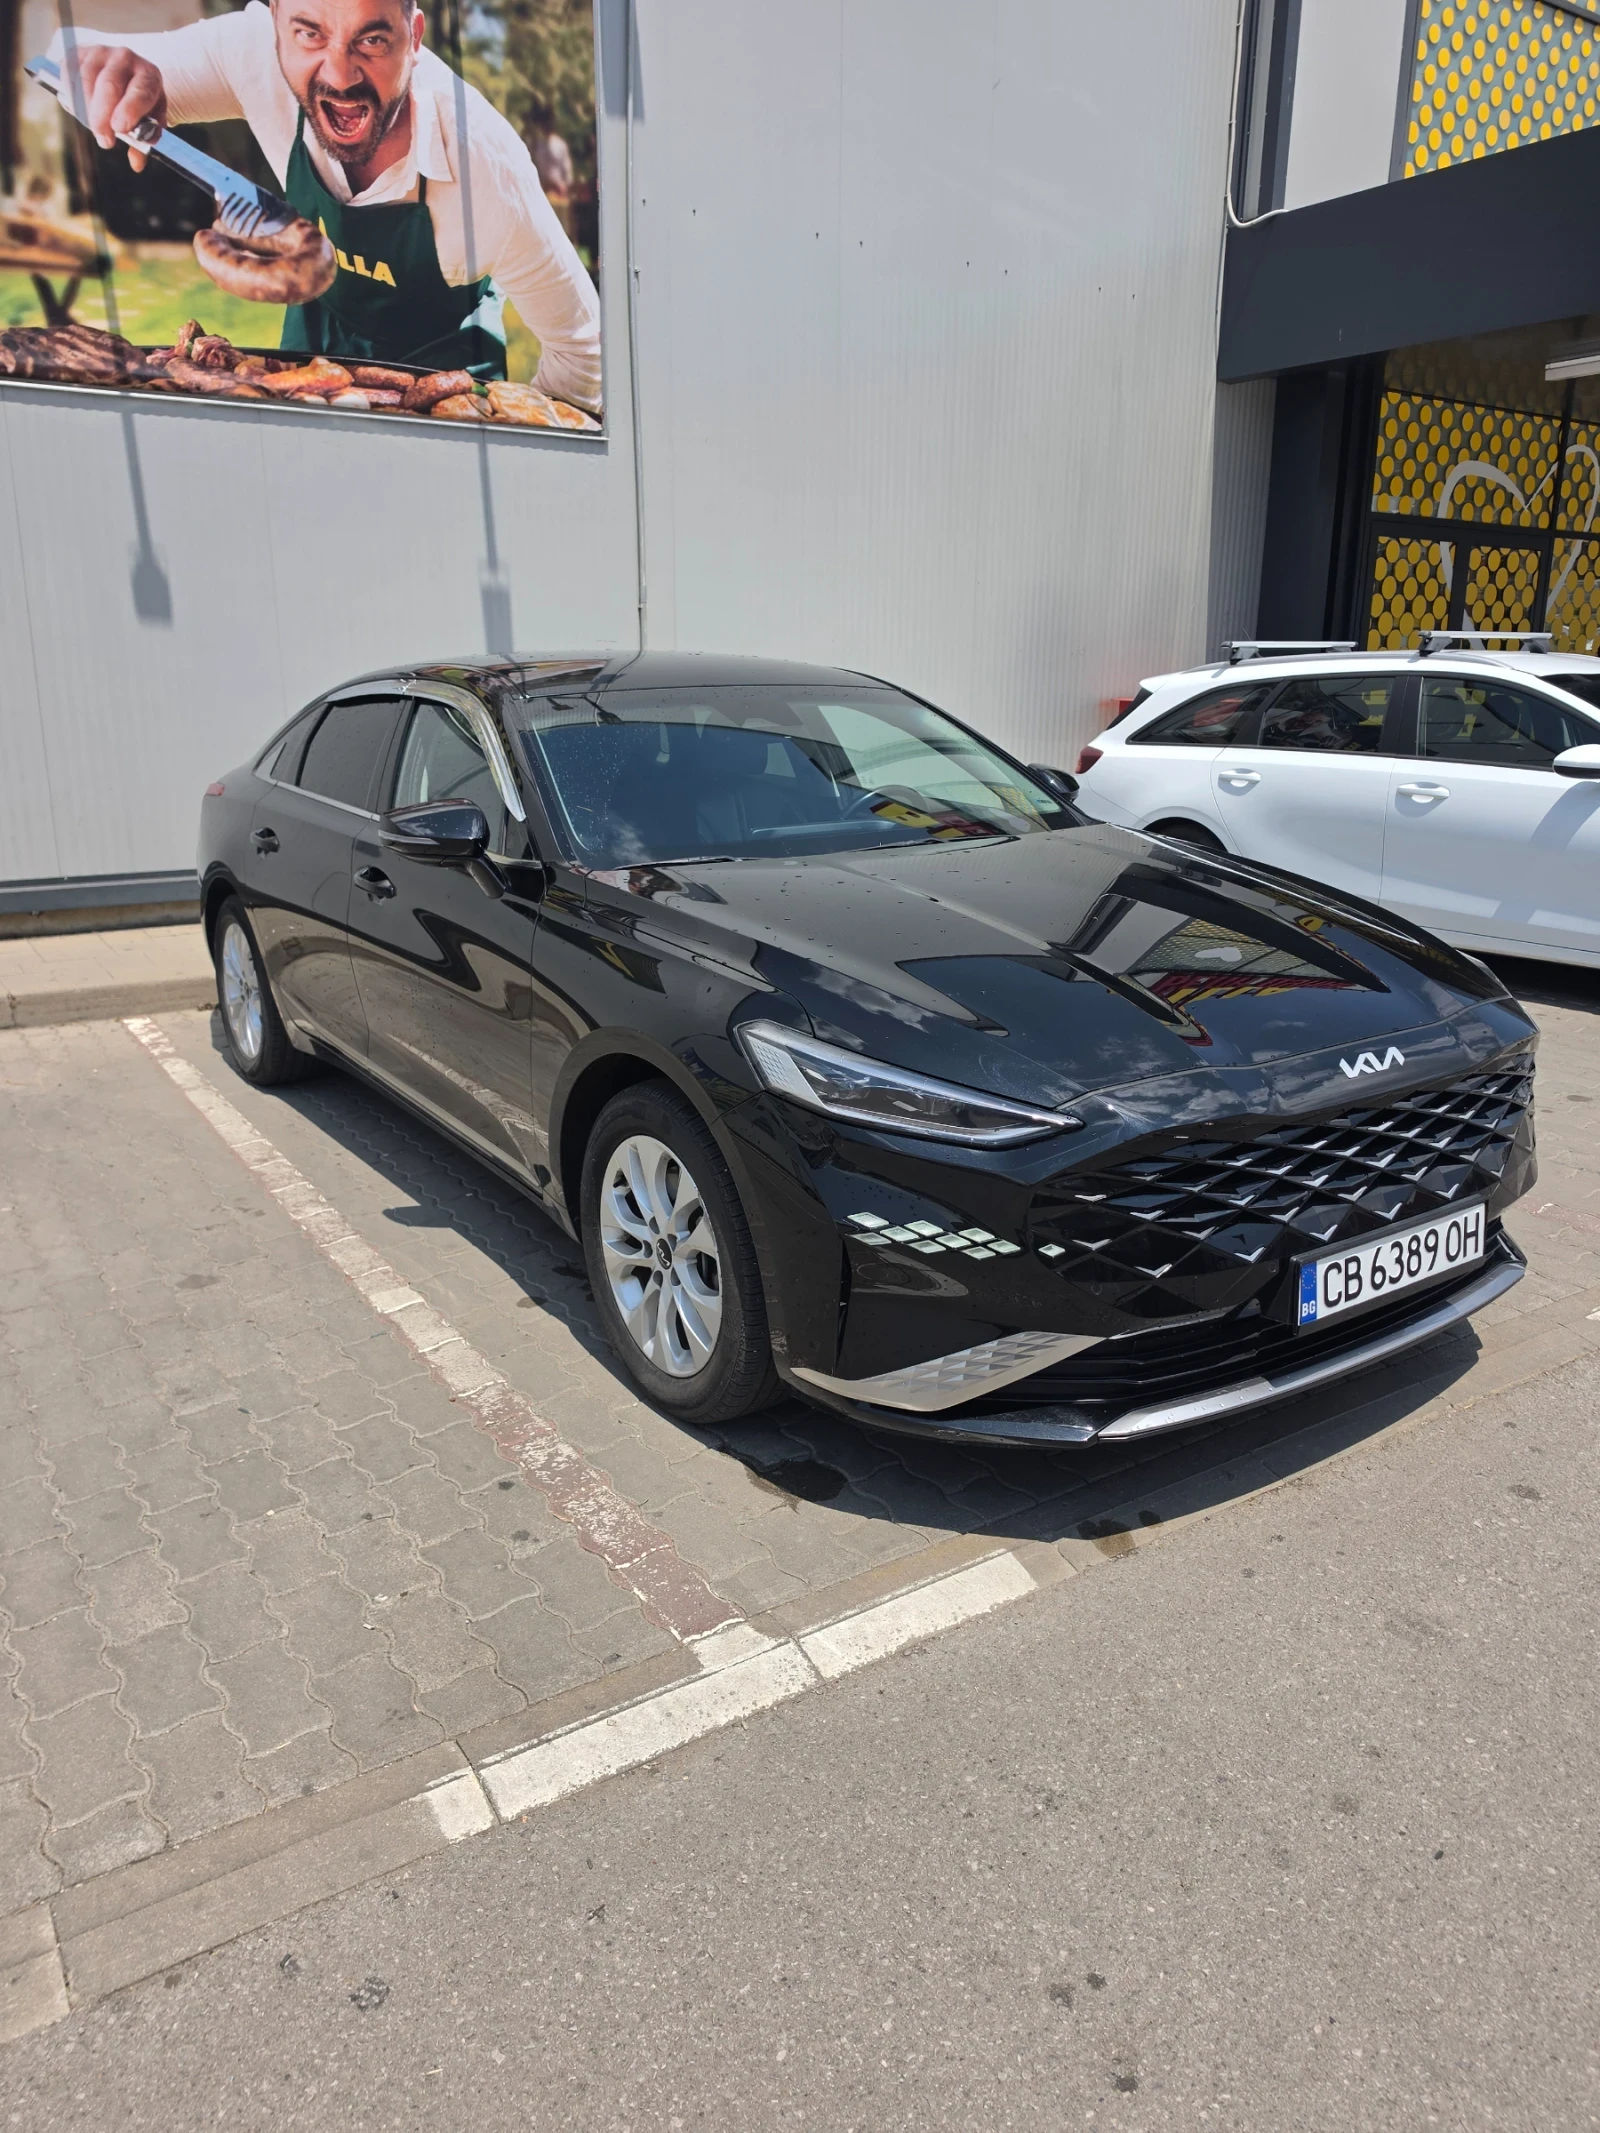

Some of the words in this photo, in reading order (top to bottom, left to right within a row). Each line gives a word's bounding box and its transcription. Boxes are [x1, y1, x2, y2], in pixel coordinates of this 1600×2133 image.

[1339, 1046, 1405, 1078] KIA
[1323, 1255, 1363, 1308] CB
[1370, 1228, 1439, 1291] 6389
[1445, 1211, 1480, 1263] OH
[1302, 1300, 1316, 1317] BG
